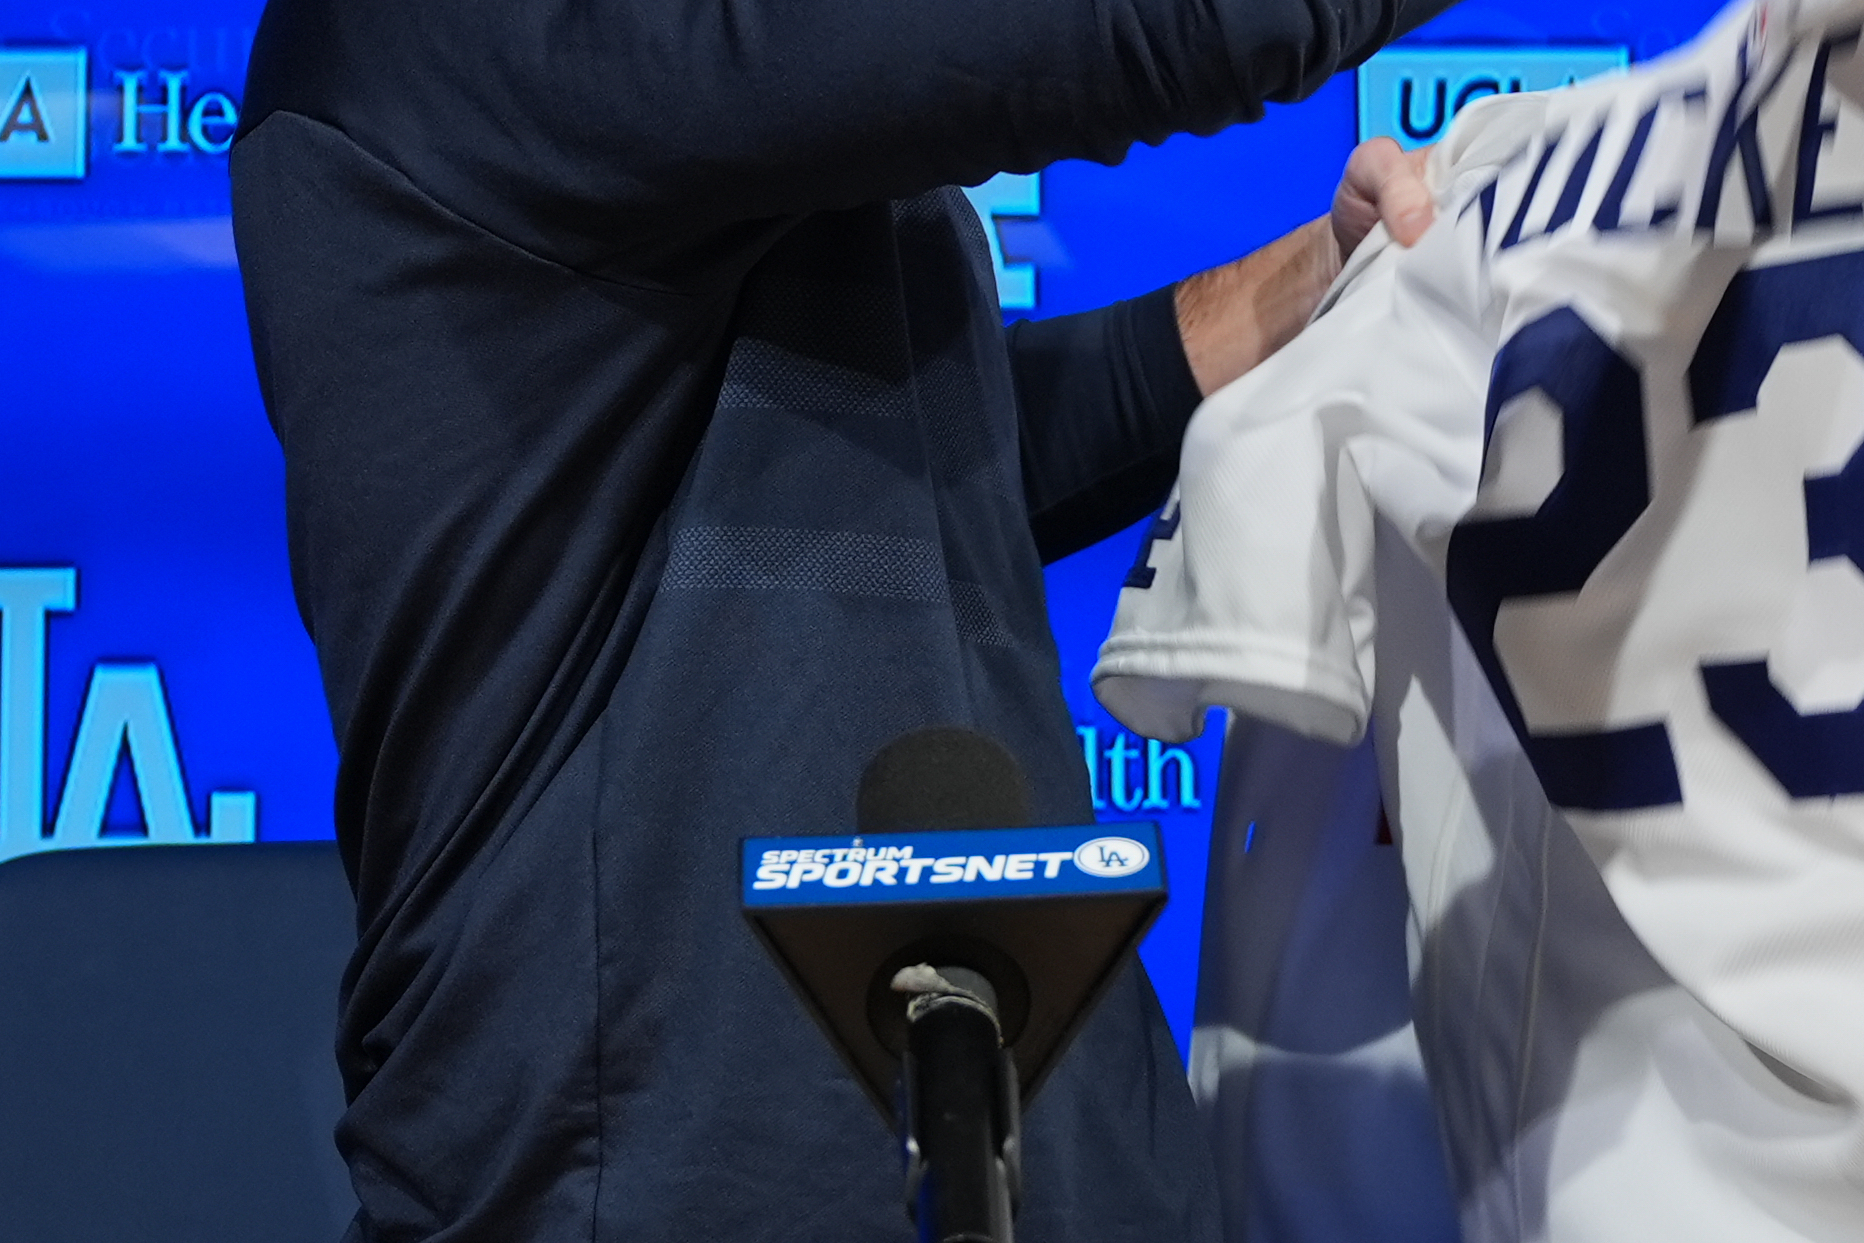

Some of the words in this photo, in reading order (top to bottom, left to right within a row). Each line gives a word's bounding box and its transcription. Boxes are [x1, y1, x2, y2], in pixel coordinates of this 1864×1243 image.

[0, 567, 257, 860] LA
[753, 851, 1076, 891] SPORTSNET
[759, 845, 914, 865] SPECTRUM
